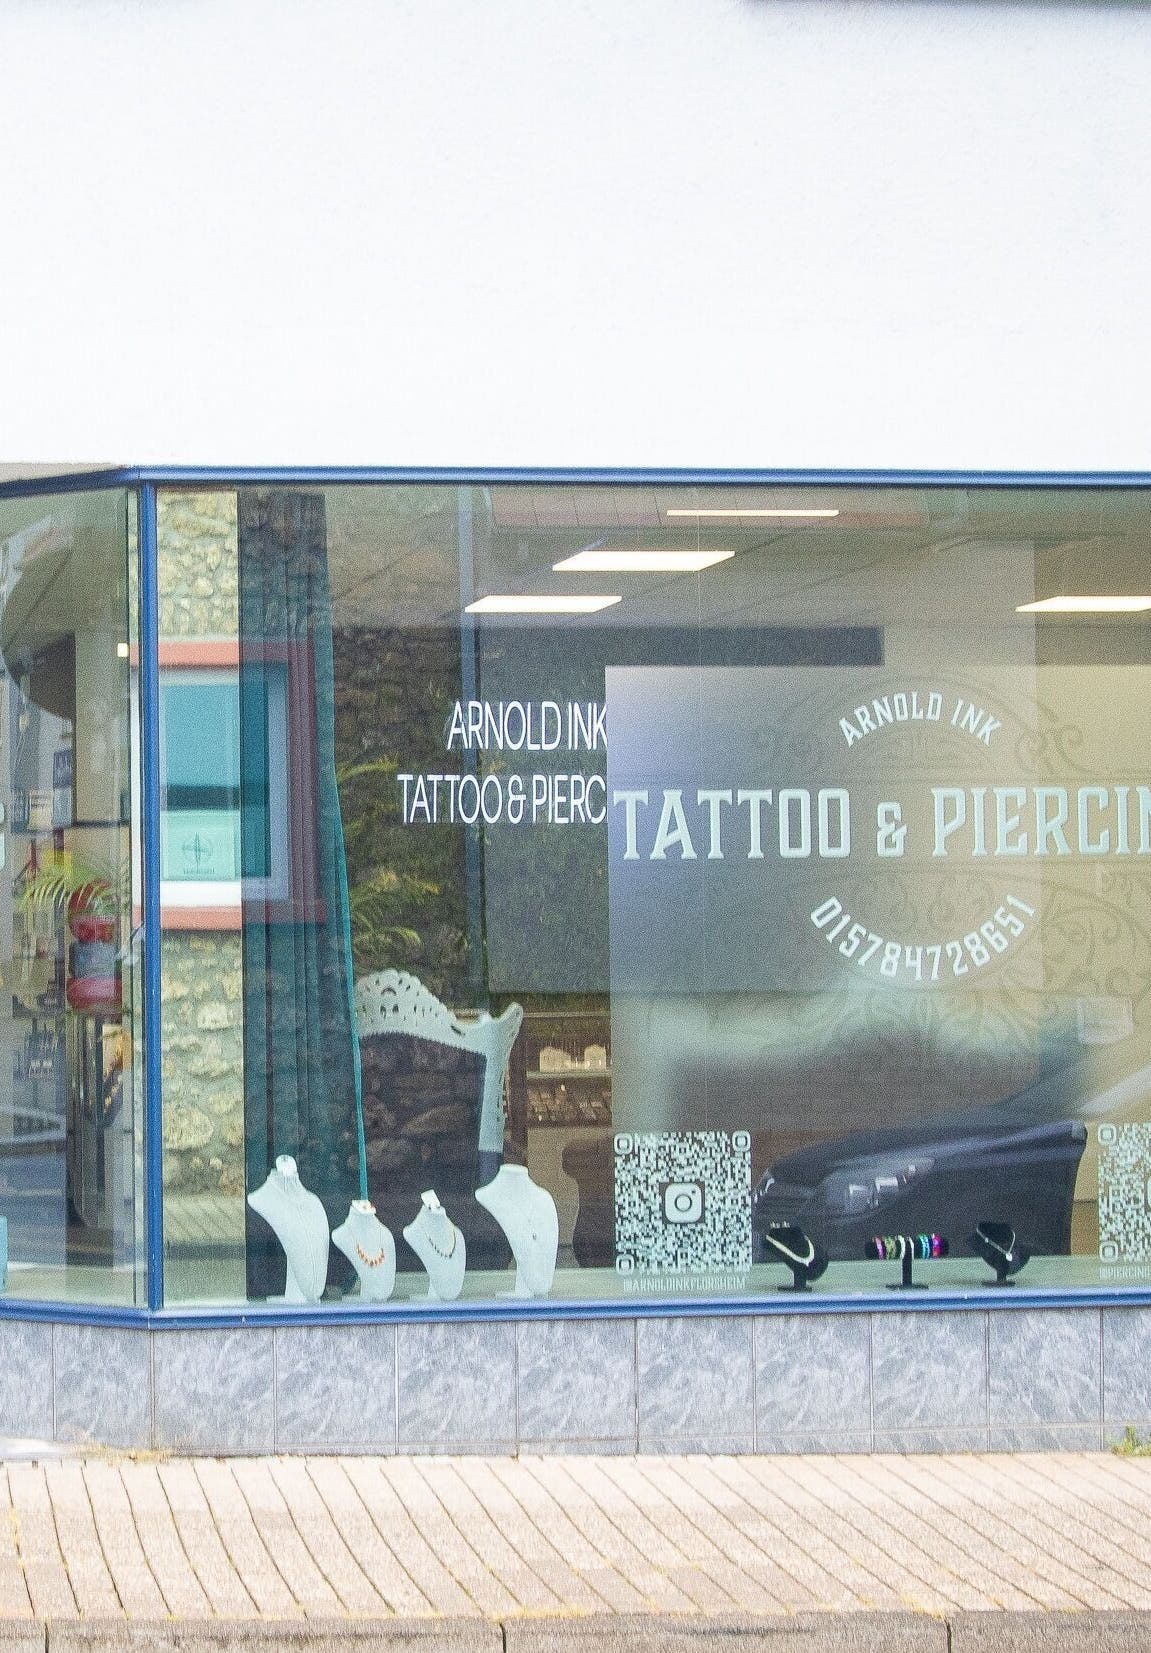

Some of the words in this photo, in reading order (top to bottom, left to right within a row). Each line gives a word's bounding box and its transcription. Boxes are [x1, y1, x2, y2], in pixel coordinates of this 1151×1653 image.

[447, 700, 562, 750] ARNOLD
[567, 701, 608, 750] INK
[839, 691, 943, 748] ARNOLD
[950, 698, 1002, 747] INK
[397, 774, 503, 824] TATTOO
[507, 774, 526, 824] &
[532, 774, 607, 824] PIERC
[613, 788, 851, 860] TATTOO
[877, 801, 907, 857] &
[811, 894, 1035, 981] 015784728651
